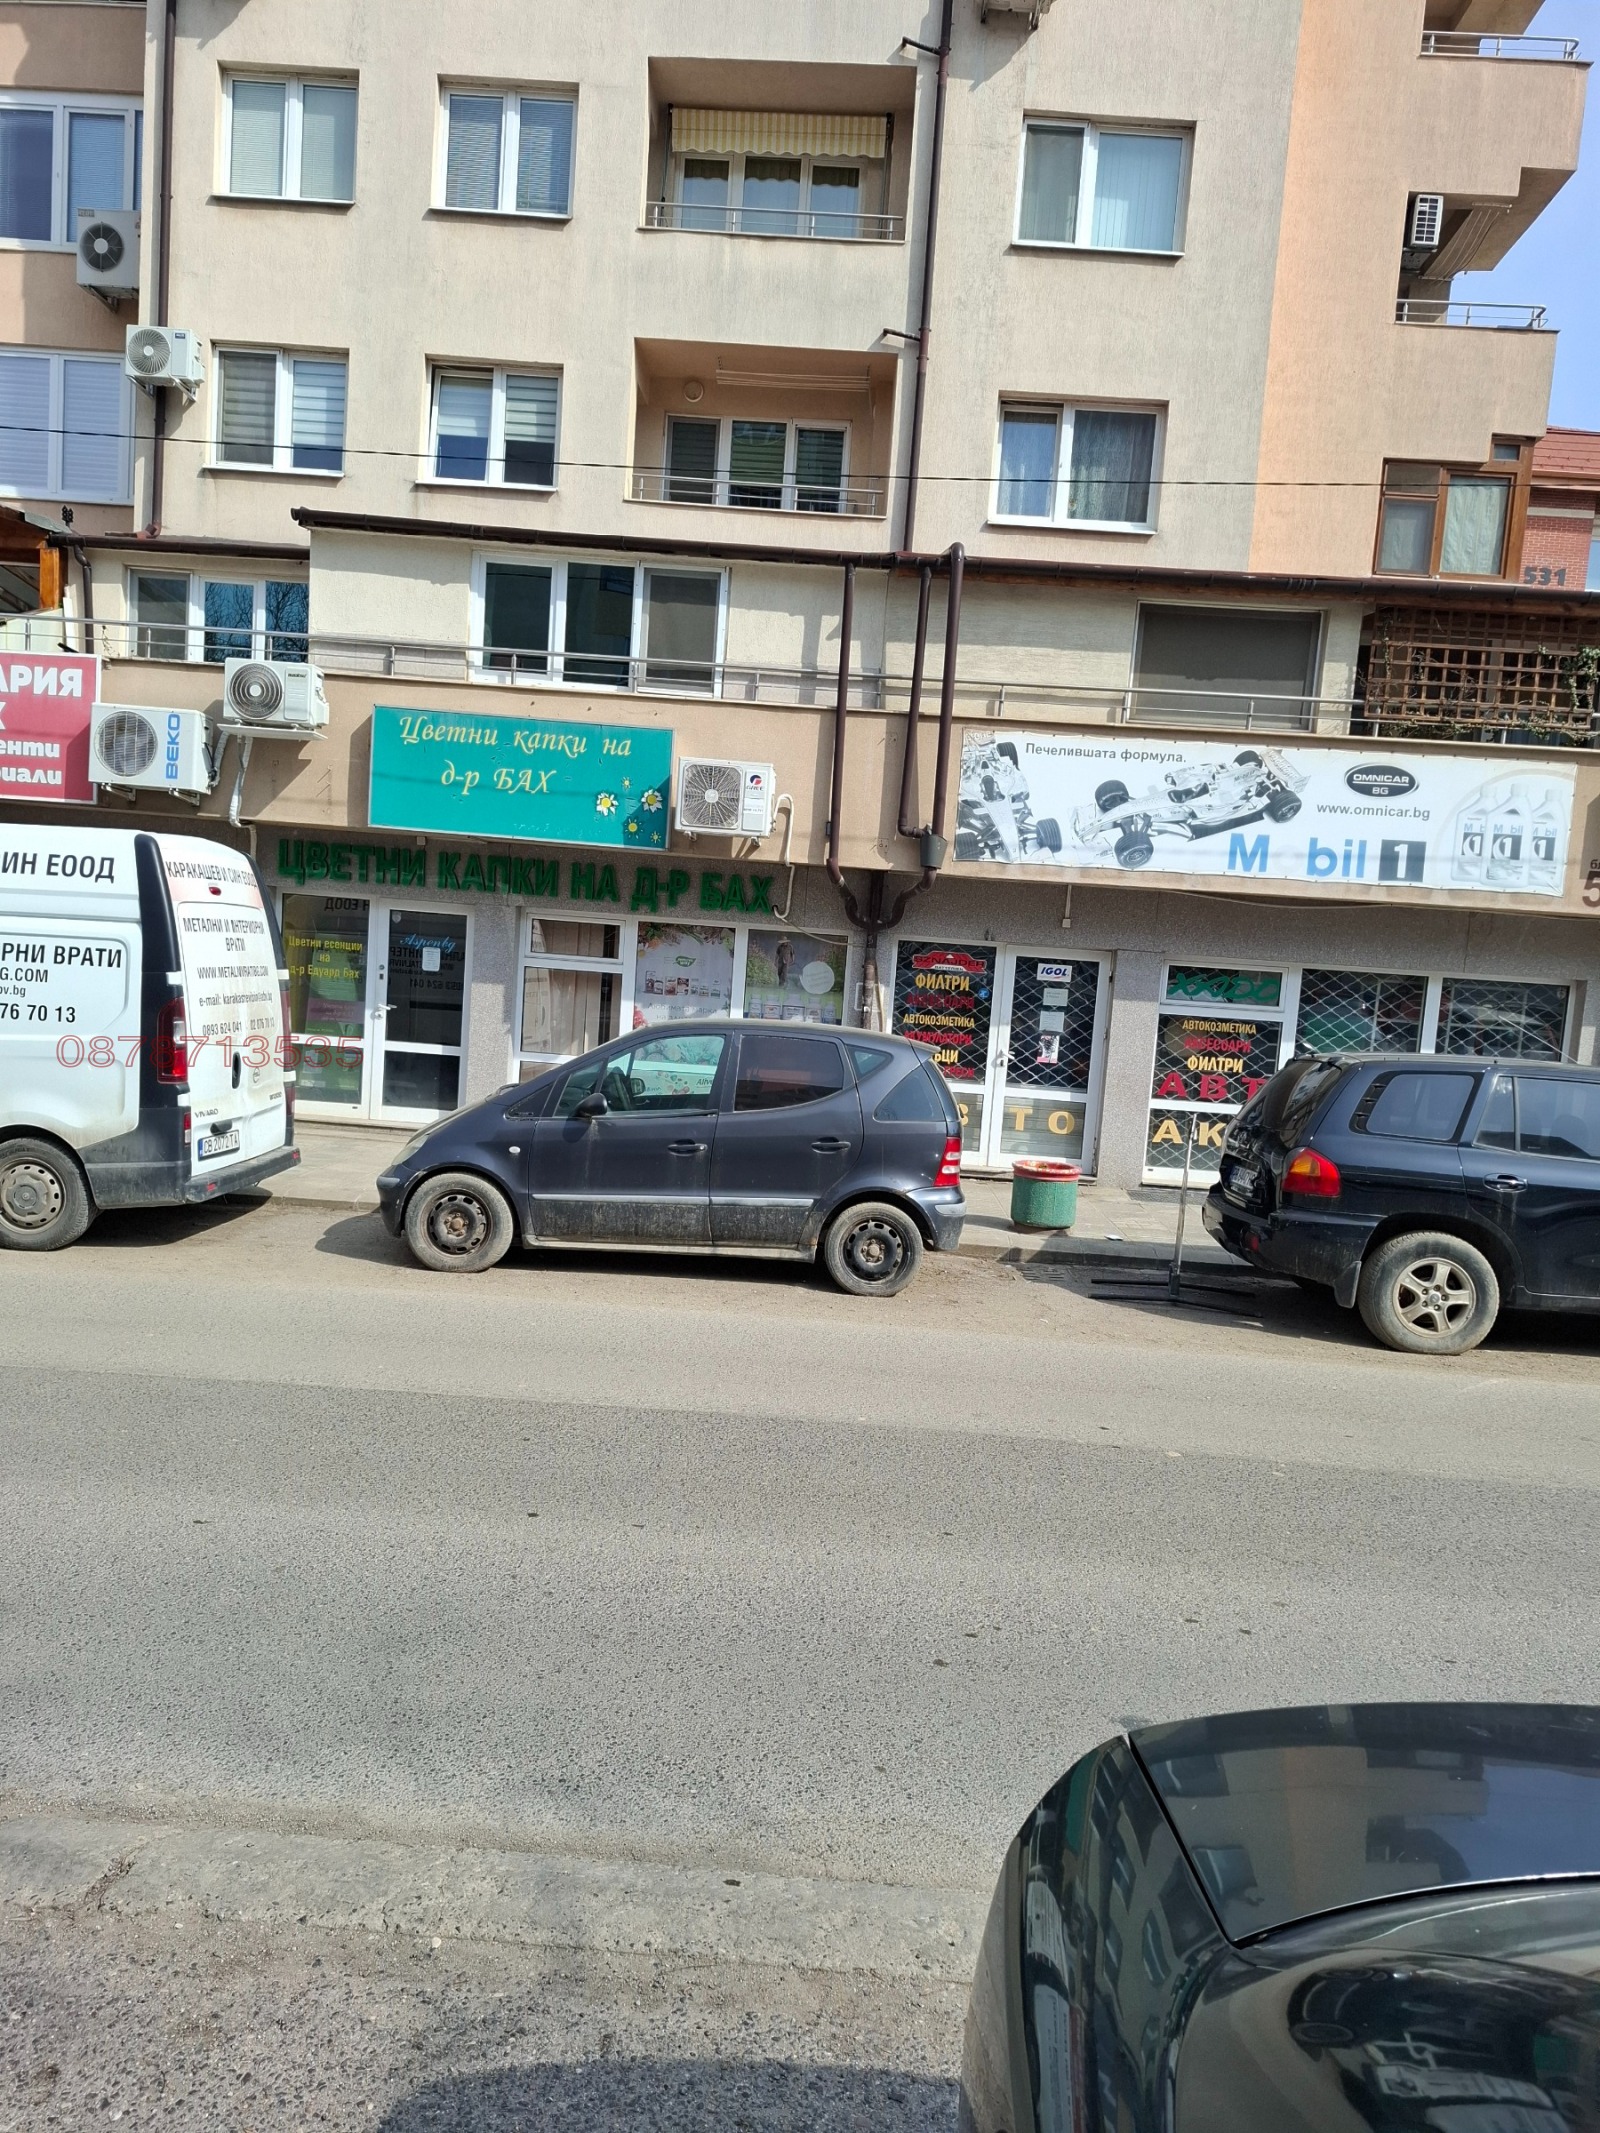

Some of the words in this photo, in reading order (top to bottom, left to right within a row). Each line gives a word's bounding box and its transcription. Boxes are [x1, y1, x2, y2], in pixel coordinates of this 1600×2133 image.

[1523, 566, 1567, 586] 531
[399, 716, 498, 745] Цветни
[513, 730, 587, 758] капки
[602, 738, 632, 756] на
[165, 713, 181, 780] BEKO
[1025, 742, 1116, 759] Печелившата
[1120, 749, 1187, 763] формула.
[0, 766, 62, 785] иали
[440, 759, 480, 795] д-р
[493, 768, 557, 793] БАХ
[1353, 774, 1410, 783] OMNICAR
[1372, 787, 1389, 795] BG
[1317, 804, 1431, 822] www.omnicar.bg
[1493, 824, 1524, 834] Mbil
[1227, 833, 1367, 878] Mbil
[46, 854, 115, 884] ЕООД
[165, 861, 222, 881] КАРАКАШЕВ
[278, 838, 427, 887] ЦВЕТНИ
[437, 851, 560, 898] КАПКИ
[570, 861, 620, 903] НА
[631, 866, 690, 913] Д-Р
[700, 871, 774, 914] БАХ
[183, 917, 224, 932] МЕТАЛНИ
[225, 937, 246, 951] ВРАТИ
[288, 935, 322, 949] Цветни
[324, 940, 363, 952] есенции
[53, 945, 122, 968] ВРАТИ
[319, 953, 331, 963] на
[307, 965, 341, 979] Едуард
[343, 967, 360, 979] Бах
[1041, 967, 1068, 977] IGOL
[915, 973, 970, 991] ФИЛТРИ
[27, 1004, 48, 1021] 70
[55, 1006, 76, 1023] 13
[903, 1013, 976, 1028] АВТОКОЗМЕТИКА
[202, 1024, 218, 1036] 0893
[220, 1022, 231, 1034] 624
[232, 1021, 242, 1033] 041
[1182, 1020, 1256, 1034] АВТОКОЗМЕТИКА
[1187, 1055, 1243, 1073] ФИЛТРИ
[194, 1108, 219, 1118] VIVARO
[213, 1134, 229, 1152] 2072
